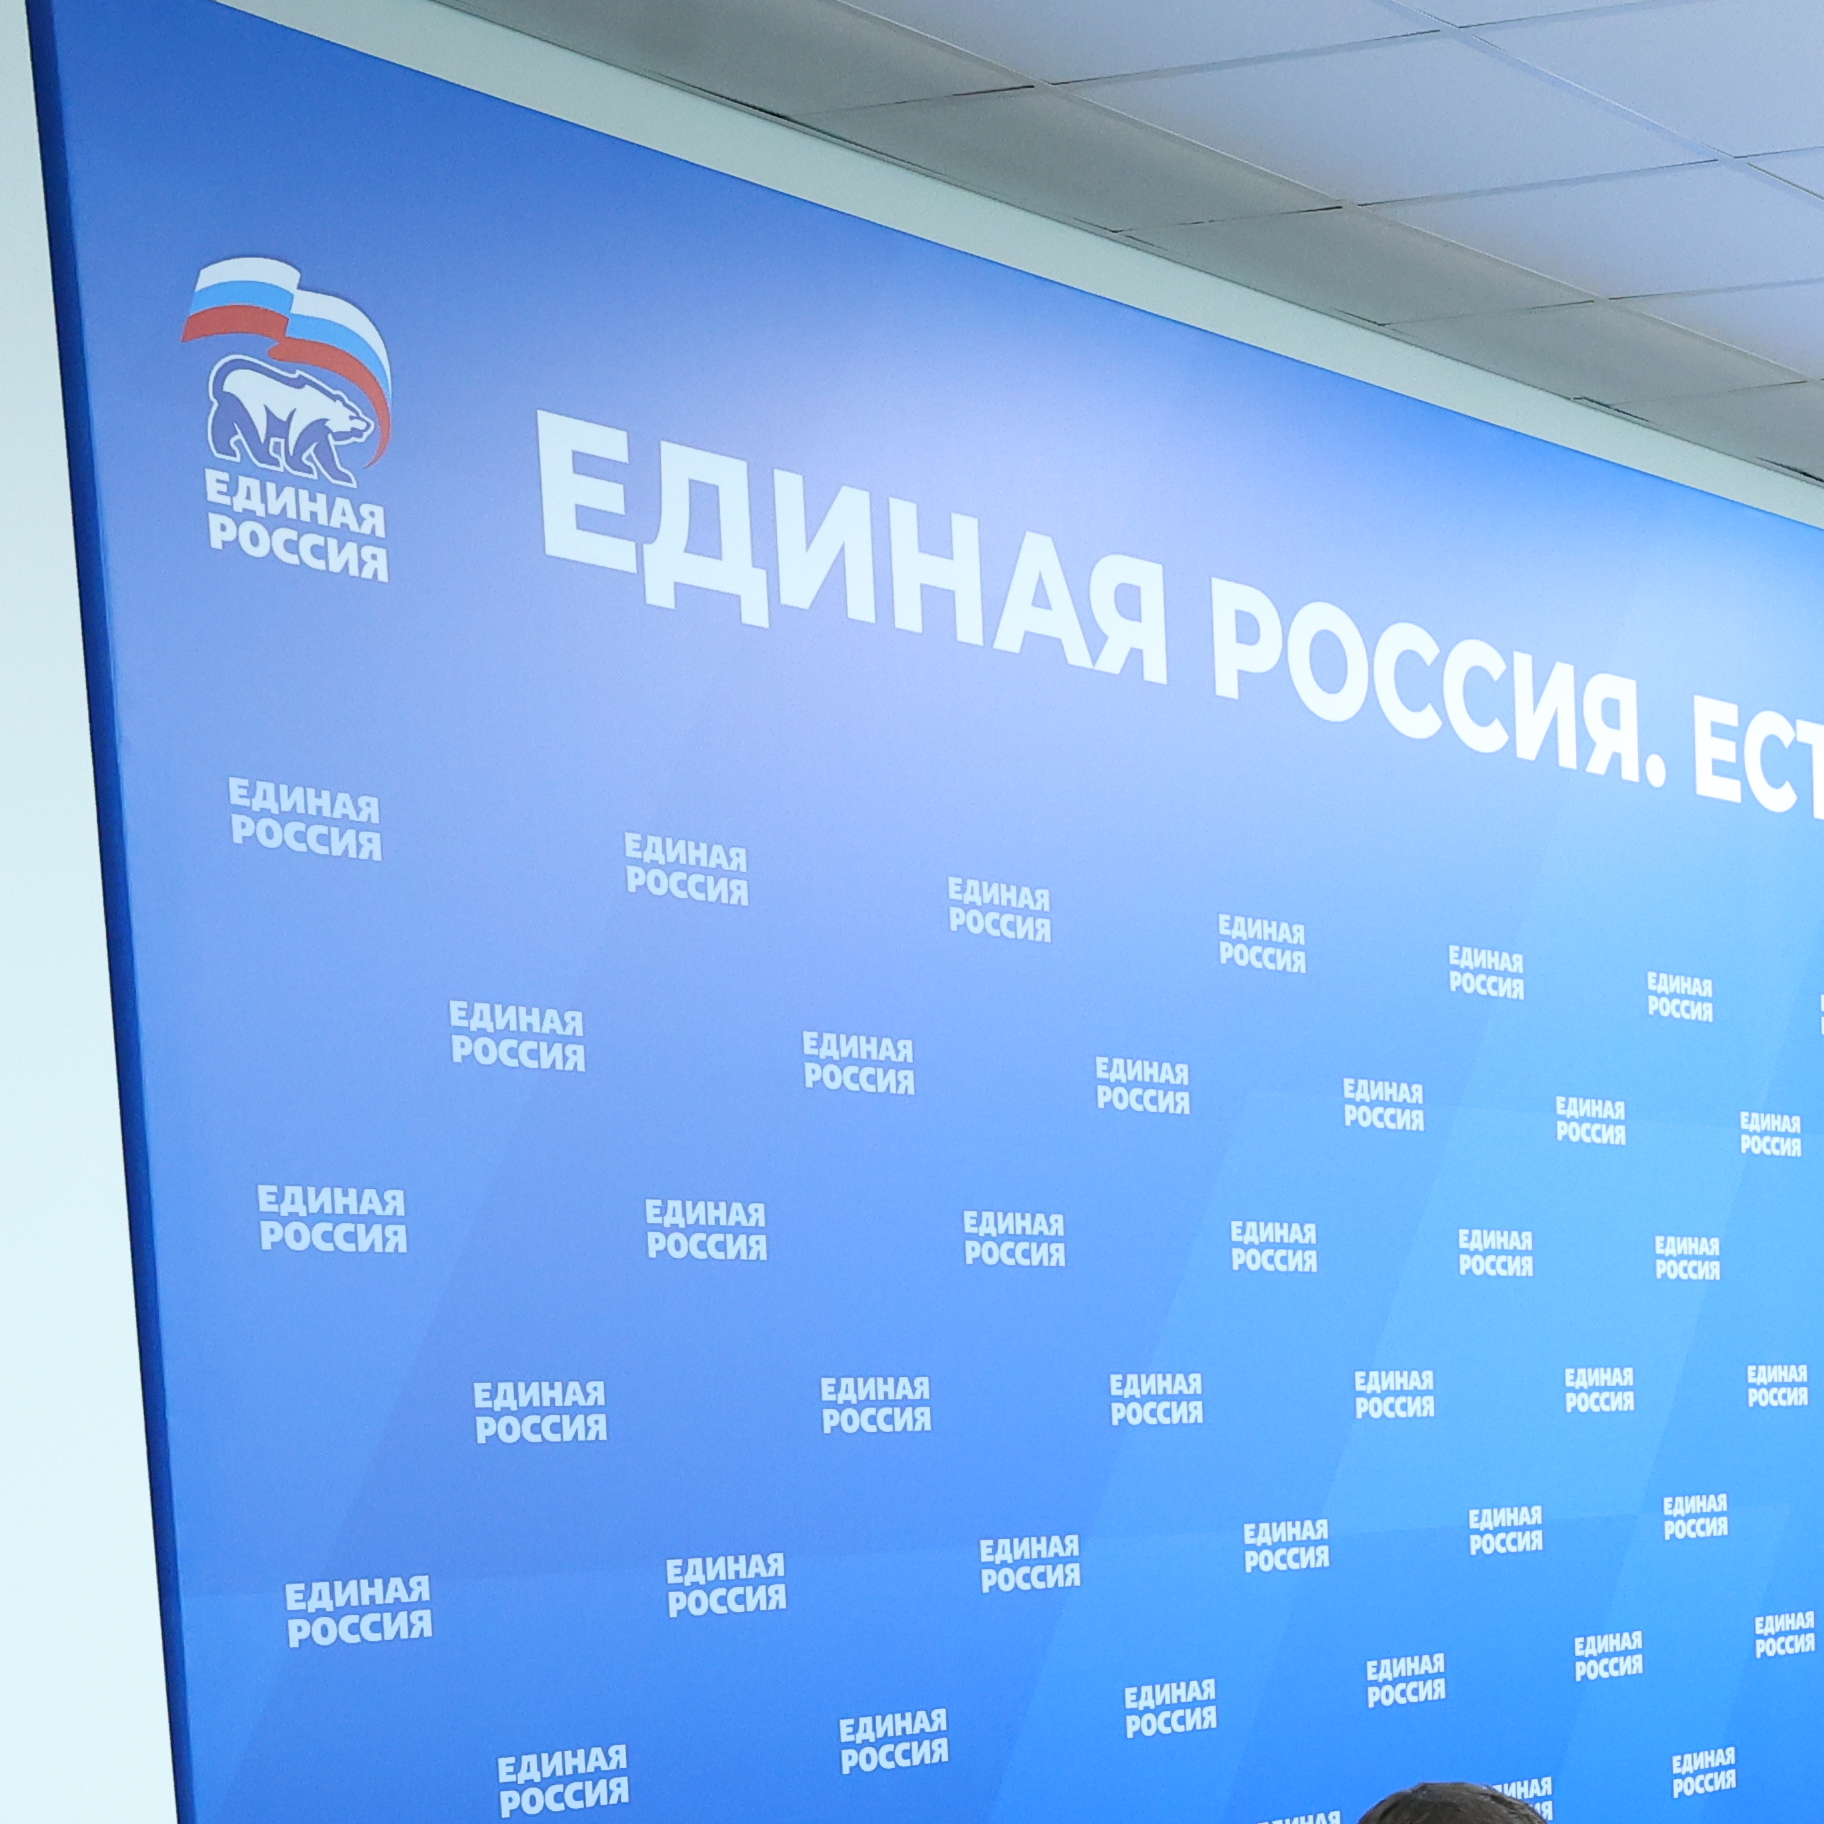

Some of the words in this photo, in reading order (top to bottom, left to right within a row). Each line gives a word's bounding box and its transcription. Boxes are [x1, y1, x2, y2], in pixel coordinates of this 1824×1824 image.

[204, 467, 386, 539] ЕДИНАЯ
[207, 511, 389, 583] РОССИЯ
[537, 410, 1167, 684] ЕДИНАЯ
[1212, 578, 1666, 787] РОССИЯ.
[229, 777, 379, 823] ЕДИНАЯ
[231, 814, 381, 861] РОССИЯ
[625, 832, 746, 872] ЕДИНАЯ
[627, 866, 748, 905] РОССИЯ
[1219, 914, 1305, 945] ЕДИНАЯ
[1220, 941, 1306, 973] РОССИЯ
[1449, 945, 1523, 973] ЕДИНАЯ
[1450, 971, 1524, 1000] РОССИЯ
[450, 1000, 583, 1036] ЕДИНАЯ
[452, 1035, 585, 1072] РОССИЯ
[1096, 1057, 1189, 1085] ЕДИНАЯ
[1097, 1085, 1190, 1114] РОССИЯ
[1343, 1078, 1423, 1104] ЕДИНАЯ
[1345, 1104, 1424, 1131] РОССИЯ
[1740, 1111, 1801, 1134] ЕДИНАЯ
[1741, 1134, 1802, 1157] РОССИЯ
[258, 1185, 405, 1216] ЕДИНАЯ
[260, 1221, 407, 1252] РОССИЯ
[964, 1211, 1064, 1237] ЕДИНАЯ
[1231, 1221, 1316, 1245] ЕДИНАЯ
[965, 1240, 1065, 1266] РОССИЯ
[1459, 1229, 1533, 1252] ЕДИНАЯ
[1232, 1248, 1317, 1272] РОССИЯ
[1459, 1254, 1534, 1276] РОССИЯ
[1355, 1370, 1434, 1394] ЕДИНАЯ
[1747, 1365, 1808, 1385] ЕДИНАЯ
[474, 1381, 605, 1411] ЕДИНАЯ
[821, 1377, 930, 1404] ЕДИНАЯ
[1748, 1387, 1808, 1407] РОССИЯ
[823, 1407, 931, 1433] РОССИЯ
[1356, 1396, 1435, 1419] РОССИЯ
[476, 1414, 607, 1444] РОССИЯ
[1469, 1505, 1542, 1531] ЕДИНАЯ
[980, 1534, 1079, 1564] ЕДИНАЯ
[1470, 1530, 1543, 1555] РОССИЯ
[666, 1553, 784, 1586] ЕДИНАЯ
[982, 1563, 1081, 1593] РОССИЯ
[286, 1575, 430, 1613] ЕДИНАЯ
[668, 1584, 786, 1618] РОССИЯ
[288, 1609, 432, 1648] РОССИЯ
[1755, 1611, 1815, 1636] ЕДИНАЯ
[1756, 1633, 1816, 1658] РОССИЯ
[1367, 1653, 1445, 1683] ЕДИНАЯ
[1125, 1678, 1216, 1711] ЕДИНАЯ
[1367, 1678, 1446, 1708] РОССИЯ
[840, 1708, 947, 1744] ЕДИНАЯ
[1126, 1705, 1217, 1738] РОССИЯ
[498, 1744, 627, 1784] ЕДИНАЯ
[841, 1737, 948, 1774] РОССИЯ
[500, 1776, 629, 1818] РОССИЯ
